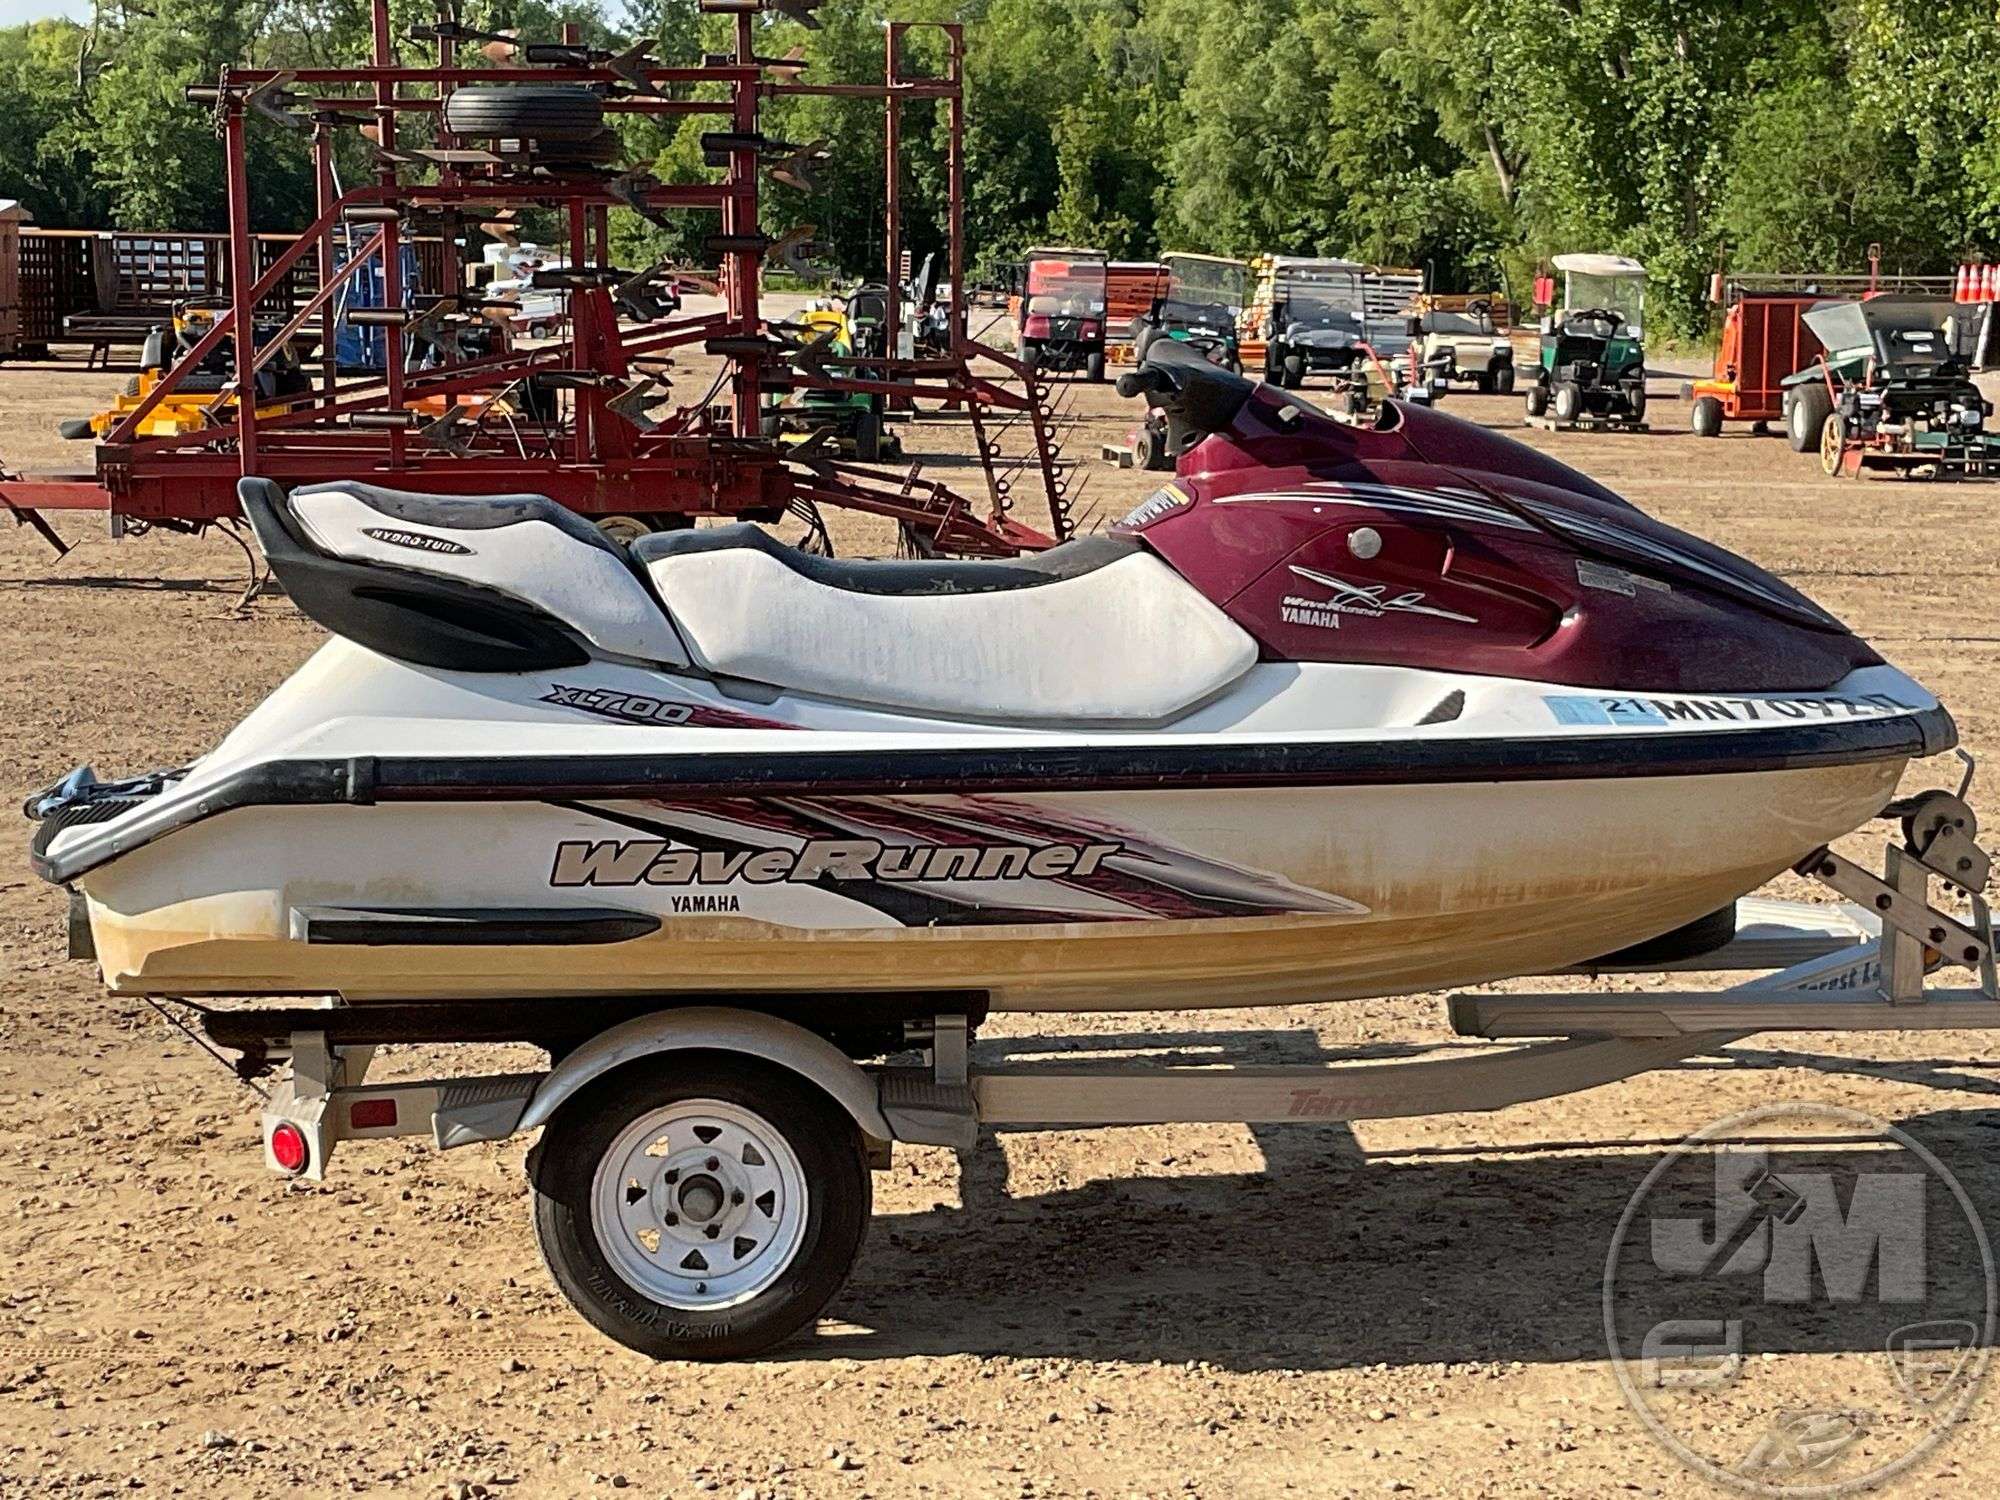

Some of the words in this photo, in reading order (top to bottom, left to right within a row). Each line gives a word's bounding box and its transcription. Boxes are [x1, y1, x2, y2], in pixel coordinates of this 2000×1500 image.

[371, 529, 461, 553] HYDRO-TURF
[1281, 606, 1340, 629] YAMAHA
[549, 683, 695, 725] XL700
[1599, 698, 1647, 713] 21
[550, 838, 1124, 886] WaveRunner
[671, 895, 740, 913] YAMAHA
[1798, 967, 1858, 990] rest
